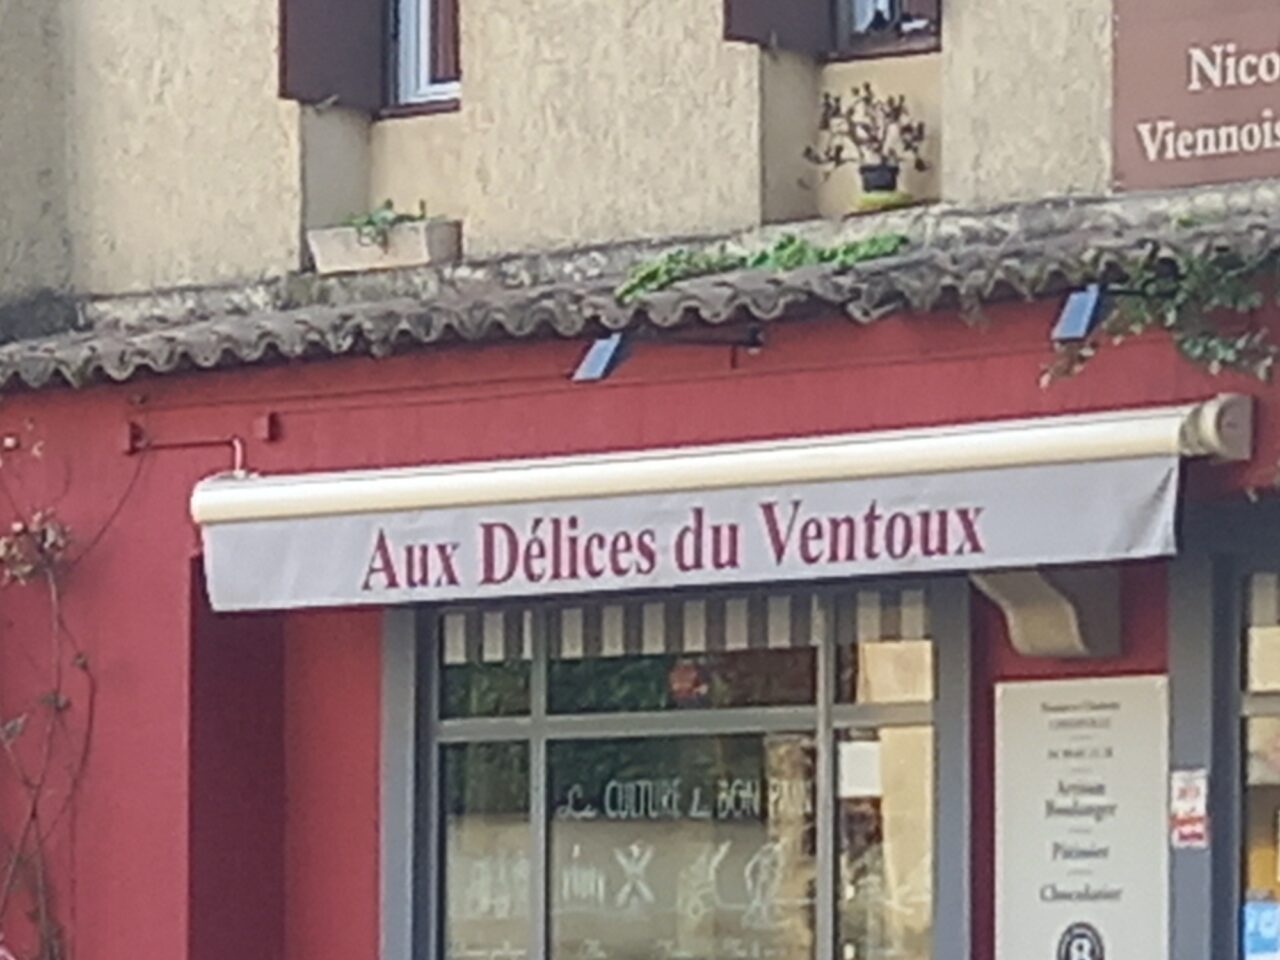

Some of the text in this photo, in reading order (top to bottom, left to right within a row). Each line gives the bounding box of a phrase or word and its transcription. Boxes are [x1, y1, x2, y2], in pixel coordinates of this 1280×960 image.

[361, 499, 985, 590] Aux Délices du Ventoux
